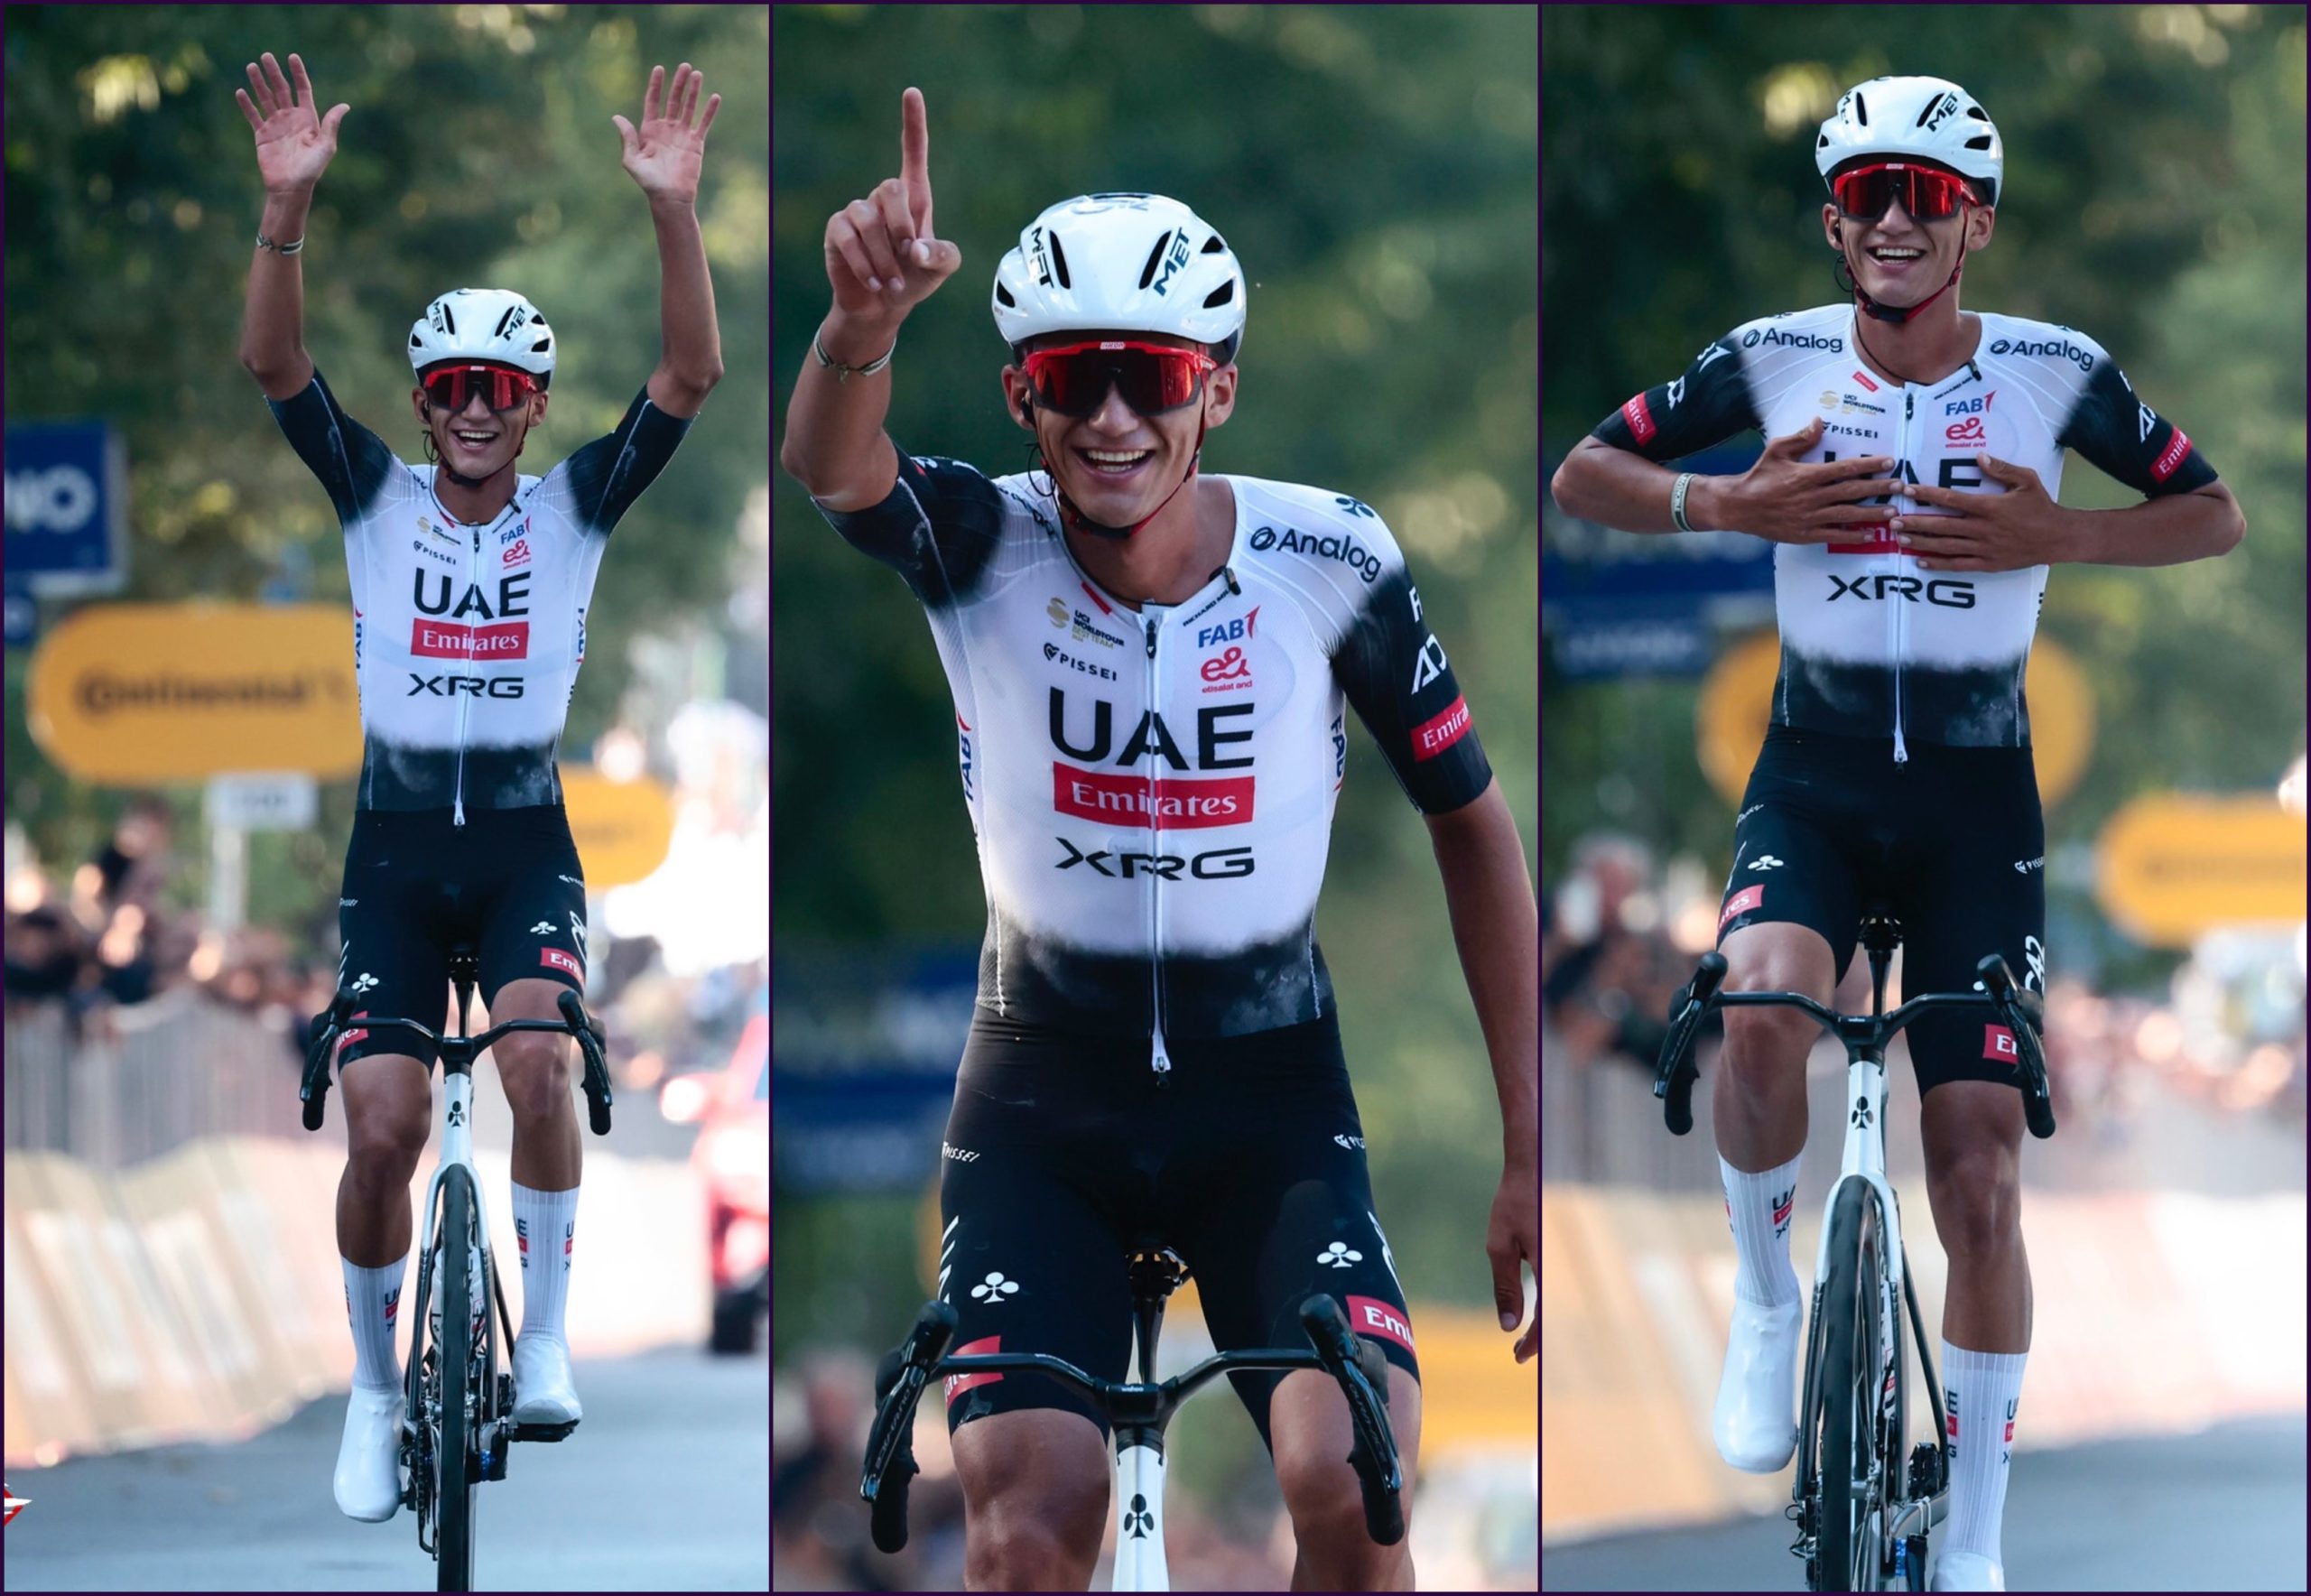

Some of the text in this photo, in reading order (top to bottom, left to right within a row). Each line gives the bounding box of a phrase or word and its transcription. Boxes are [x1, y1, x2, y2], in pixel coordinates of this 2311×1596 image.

[1926, 91, 1959, 132] MET
[1032, 226, 1054, 289] MET
[1153, 227, 1190, 297] MET
[432, 301, 446, 334] MET
[503, 305, 526, 341] MET
[1762, 328, 1843, 353] Analog
[2010, 339, 2094, 372] Analog
[1832, 425, 1879, 439] PISSEI
[422, 546, 456, 565] PISSEI
[1276, 528, 1382, 583] Analog
[414, 567, 532, 620] UAE
[1826, 575, 1976, 609] XRG
[1073, 617, 1125, 646] WORLDTOUR
[1074, 609, 1091, 624] UCI
[422, 629, 519, 652] Emirates
[1060, 653, 1117, 682] PISSEI
[407, 673, 524, 699] XRG
[1049, 686, 1256, 771] UAE
[1072, 780, 1238, 817] Emirates
[1054, 836, 1256, 881] XRG
